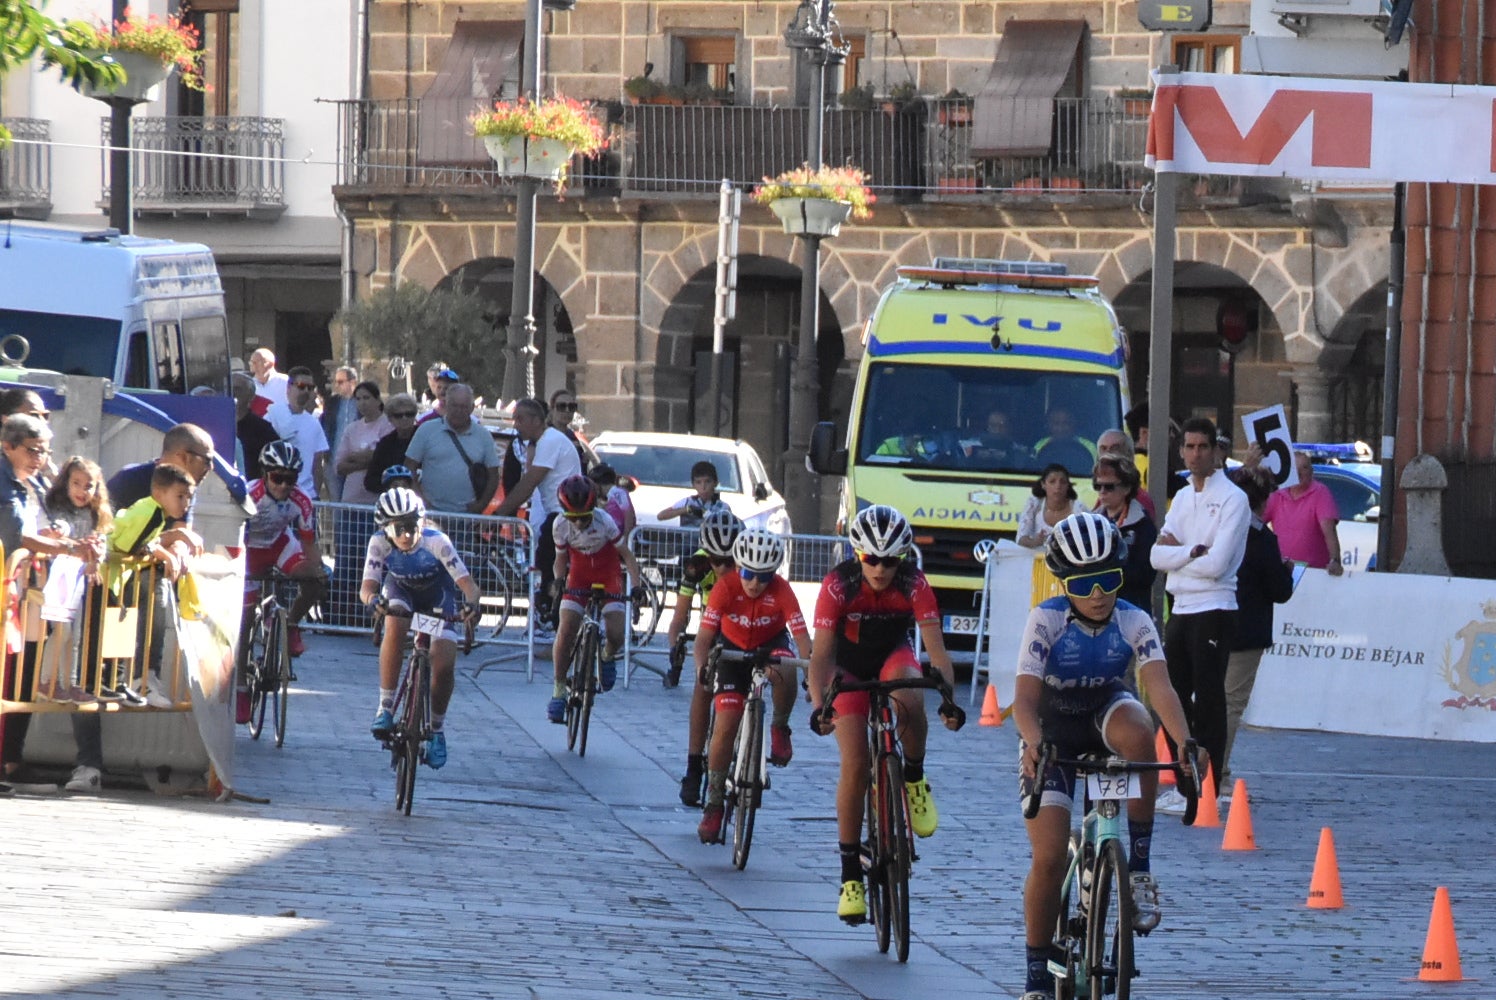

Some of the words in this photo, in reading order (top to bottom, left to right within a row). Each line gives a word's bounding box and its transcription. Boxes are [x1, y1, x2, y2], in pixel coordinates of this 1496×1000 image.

[1252, 413, 1292, 485] 5
[1281, 622, 1339, 638] Excmo.
[1340, 647, 1367, 661] DE
[1370, 646, 1425, 667] BÉJAR
[1099, 778, 1127, 797] 78
